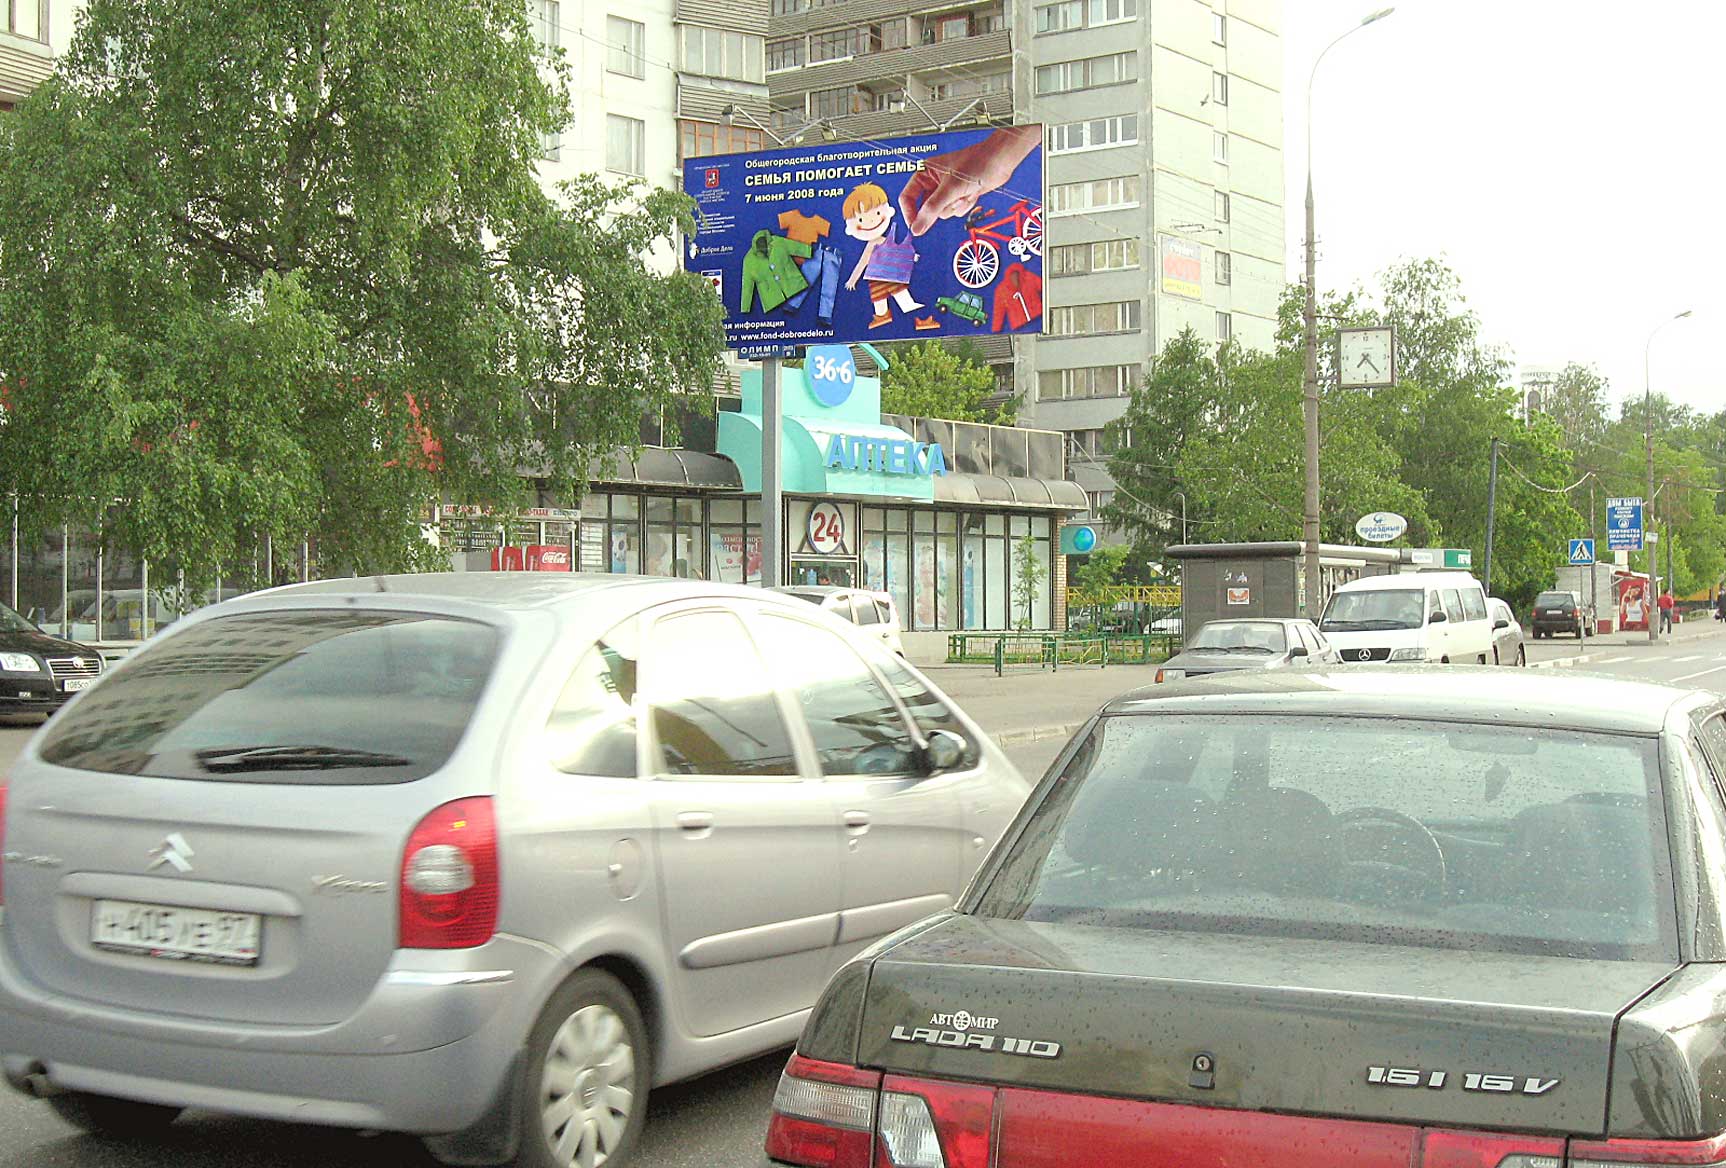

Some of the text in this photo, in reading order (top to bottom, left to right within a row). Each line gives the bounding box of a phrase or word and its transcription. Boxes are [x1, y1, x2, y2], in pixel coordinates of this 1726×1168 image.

[745, 155, 815, 169] Общегородская
[817, 146, 908, 163] благотворительная
[910, 144, 937, 155] акция
[744, 160, 926, 187] СЕМЬЯ ПОМОГАЕТ СЕМЬЕ
[744, 187, 844, 204] 7 июня 2008 года
[734, 319, 785, 331] информация
[740, 329, 834, 341] www.fond-dobroedelo.ru
[740, 345, 779, 354] ОЛИМП
[826, 433, 947, 477] АПТЕКА
[813, 512, 841, 544] 24
[1360, 525, 1400, 533] проездные
[541, 551, 568, 564] Coca-Cola
[891, 1025, 1062, 1058] LADA 110
[1463, 1072, 1514, 1092] 16
